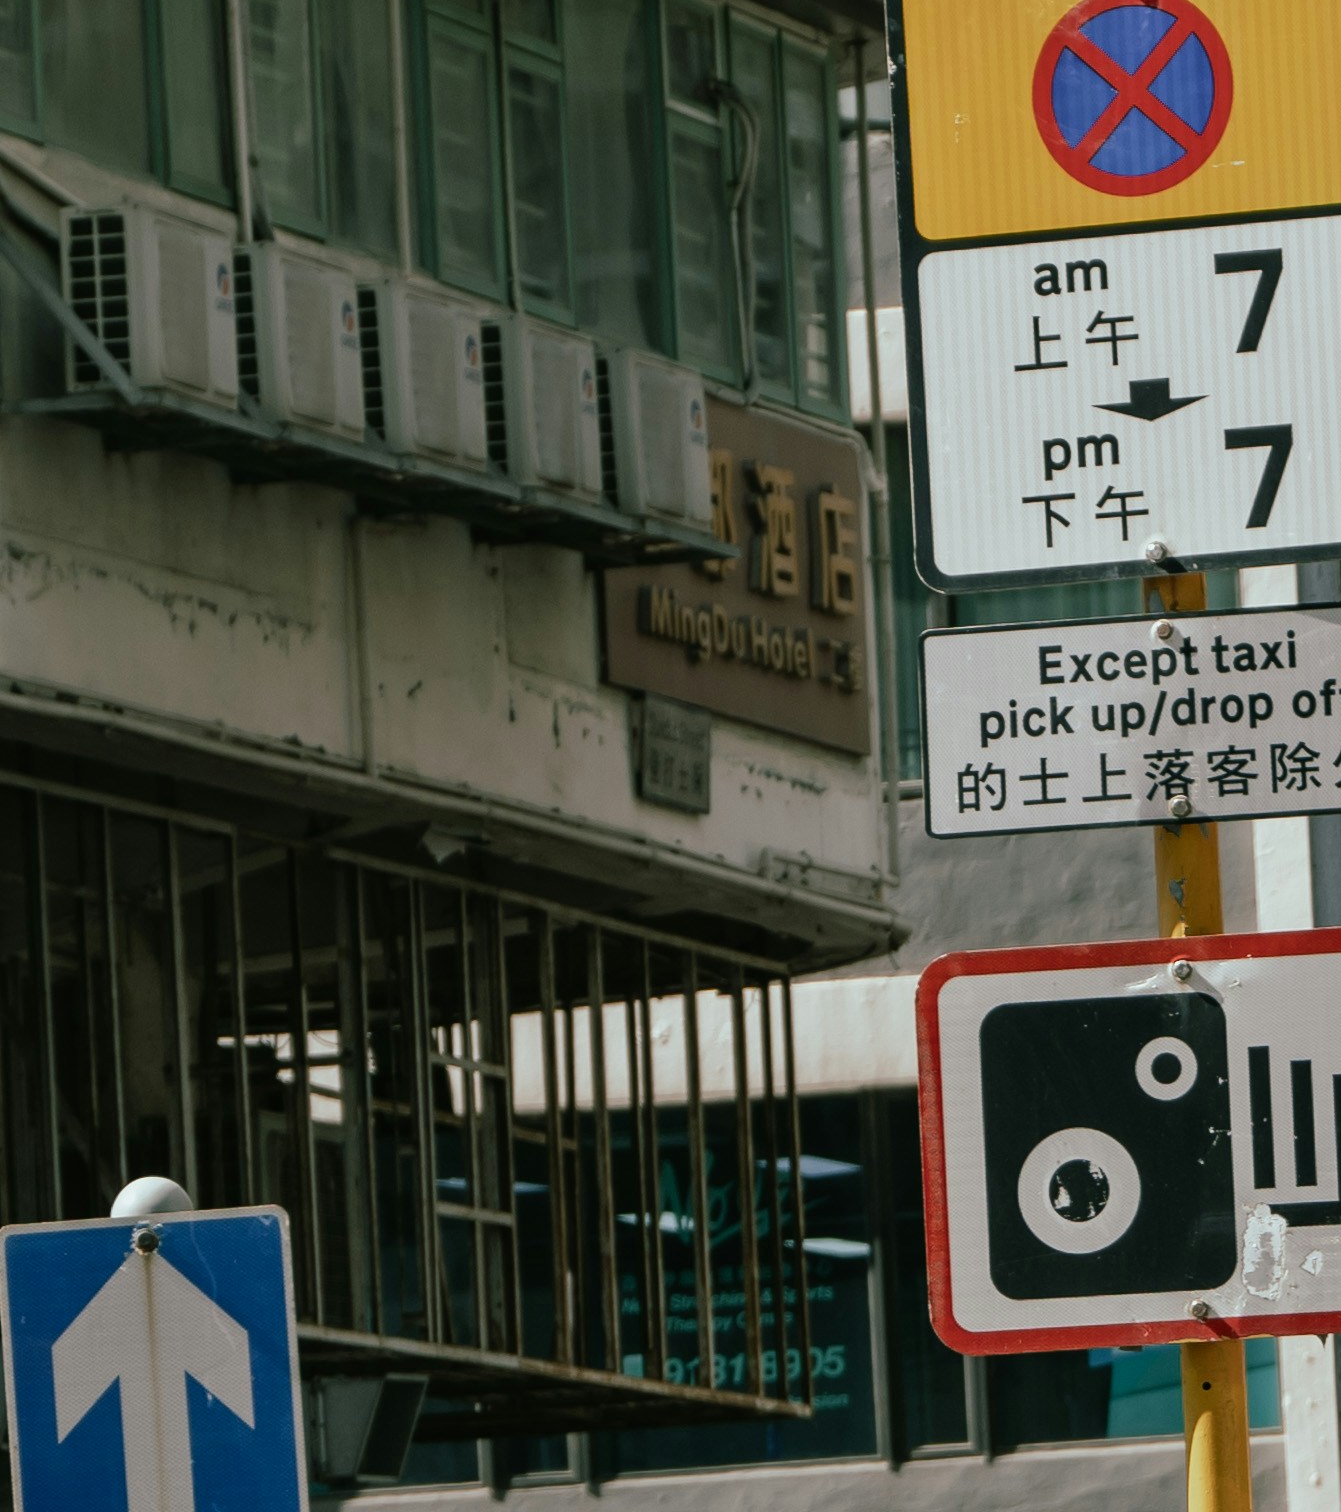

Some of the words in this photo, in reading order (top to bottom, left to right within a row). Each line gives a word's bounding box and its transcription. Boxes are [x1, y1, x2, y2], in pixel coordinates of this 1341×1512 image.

[1033, 254, 1109, 296] am
[1214, 249, 1283, 354] 7
[1013, 310, 1140, 372] 上午
[1041, 431, 1120, 482] pm
[1223, 424, 1293, 529] 7
[1022, 486, 1150, 548] 下午
[750, 615, 815, 677] Hotel
[1038, 635, 1199, 688] Except
[1210, 630, 1296, 673] taxi
[979, 697, 1075, 748] pick
[1089, 682, 1273, 738] up/drop
